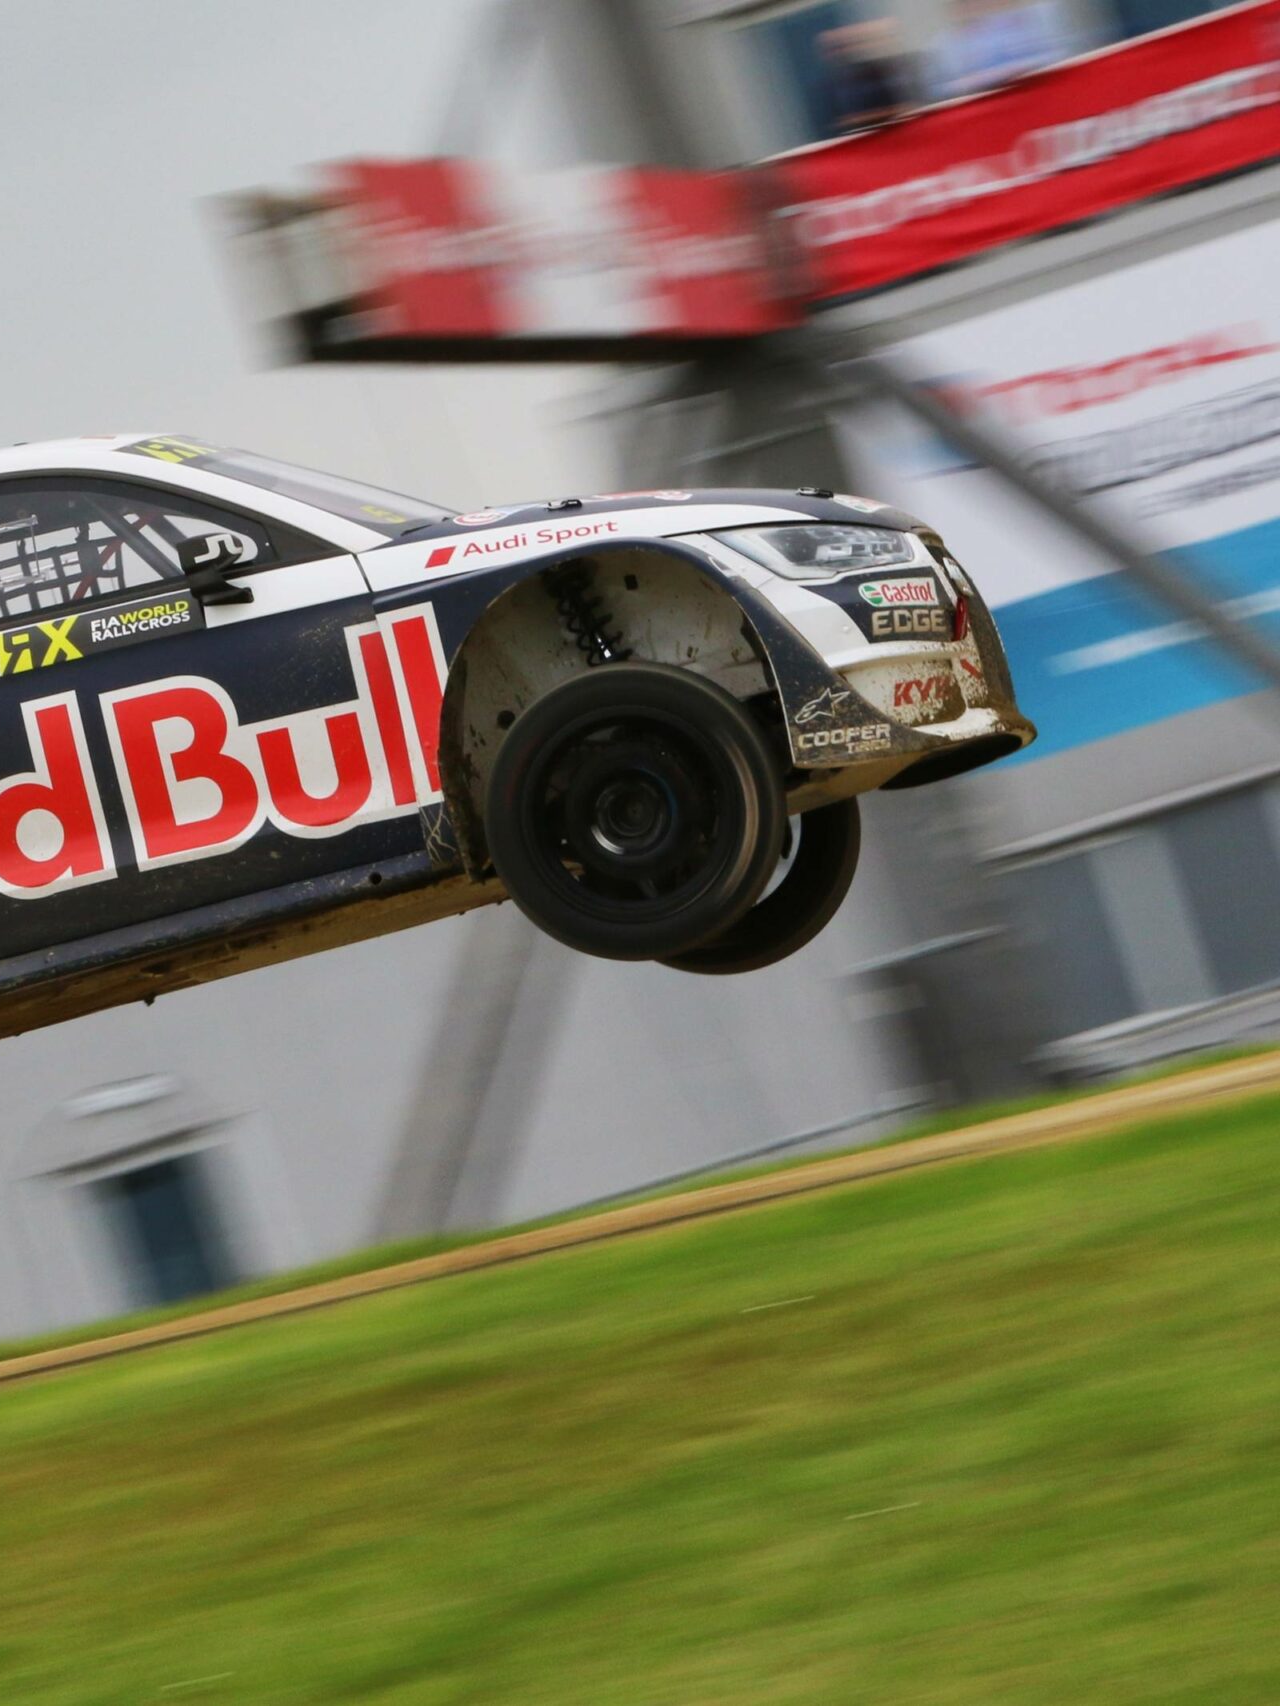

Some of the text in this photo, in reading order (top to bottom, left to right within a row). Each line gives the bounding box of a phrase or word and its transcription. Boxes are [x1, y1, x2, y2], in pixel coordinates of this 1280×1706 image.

[463, 521, 619, 557] Audi Sport
[881, 581, 936, 604] Castrol
[91, 611, 191, 643] RALLYCROSS
[871, 608, 949, 636] EDGE
[114, 615, 444, 858] Bull
[798, 724, 891, 750] COOPER
